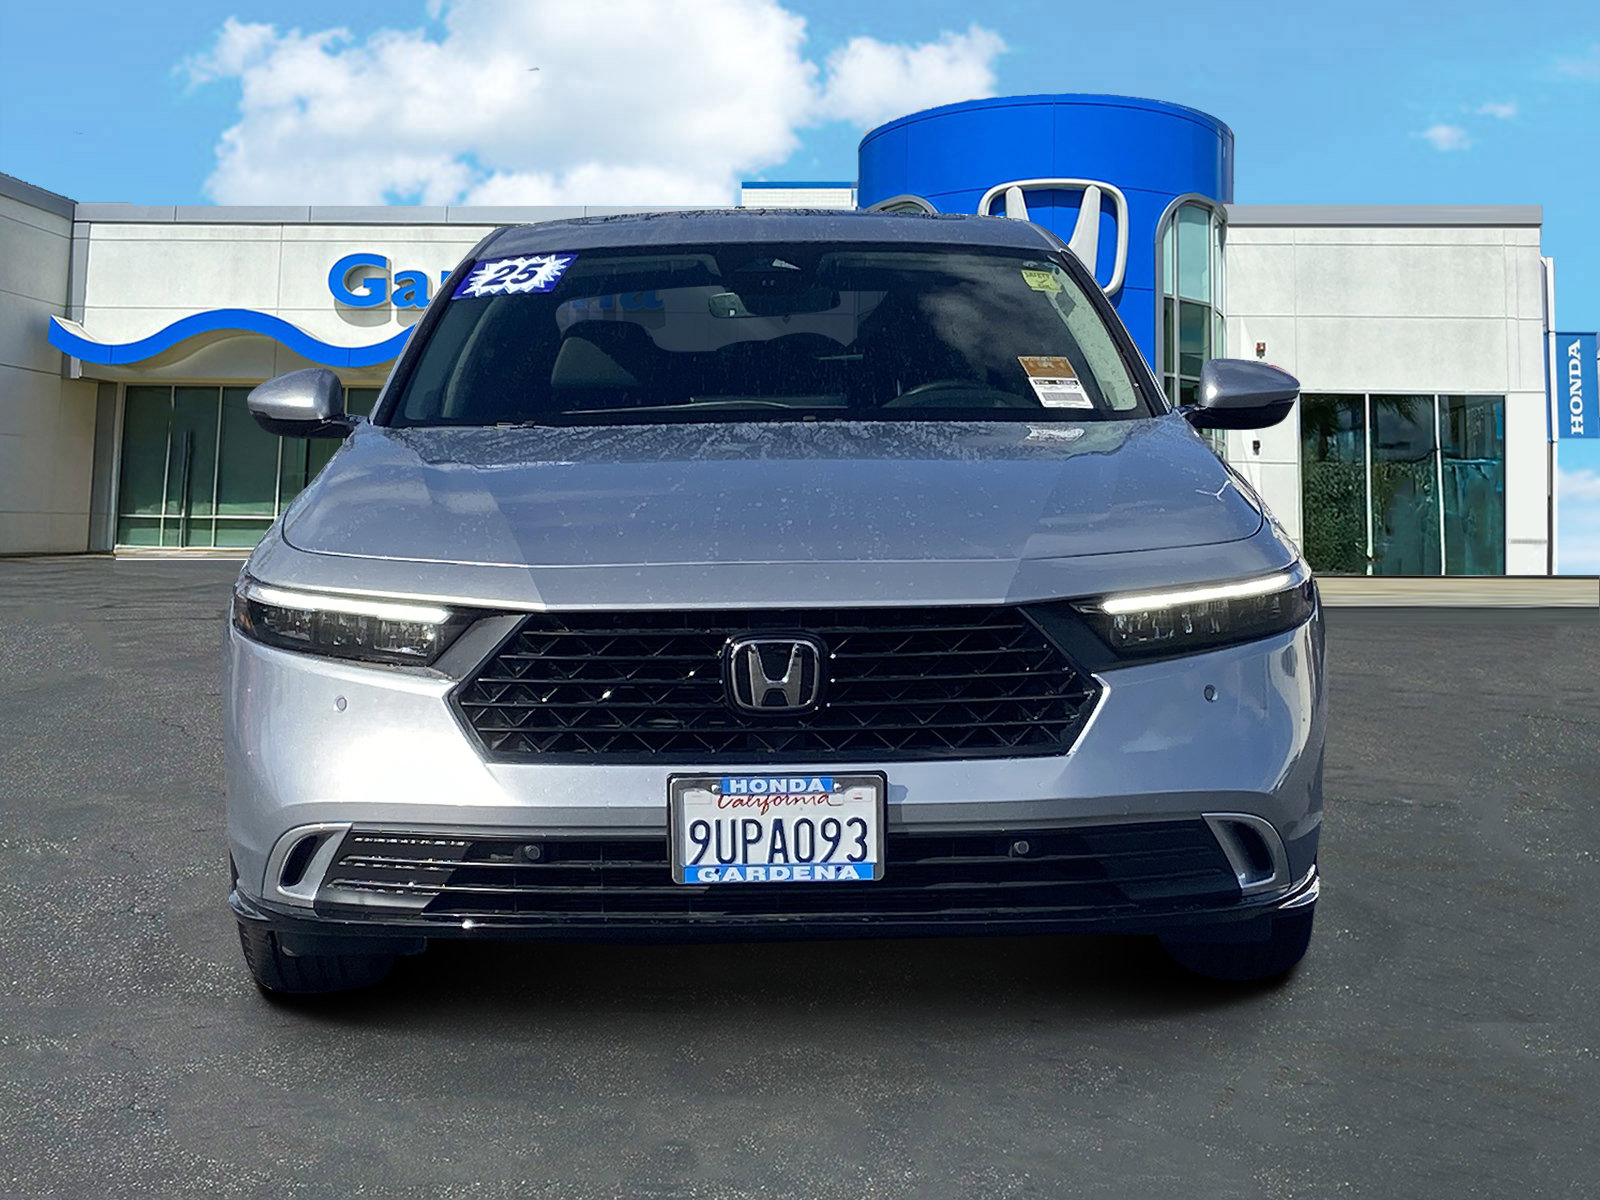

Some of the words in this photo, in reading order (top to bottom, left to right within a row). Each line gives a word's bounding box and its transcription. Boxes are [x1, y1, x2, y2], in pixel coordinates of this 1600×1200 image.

[482, 262, 546, 286] 25
[1568, 338, 1585, 435] HONDA
[730, 778, 827, 794] HONDA
[717, 793, 843, 816] California
[686, 817, 869, 865] 9UPA093
[697, 865, 860, 882] GARDENA
